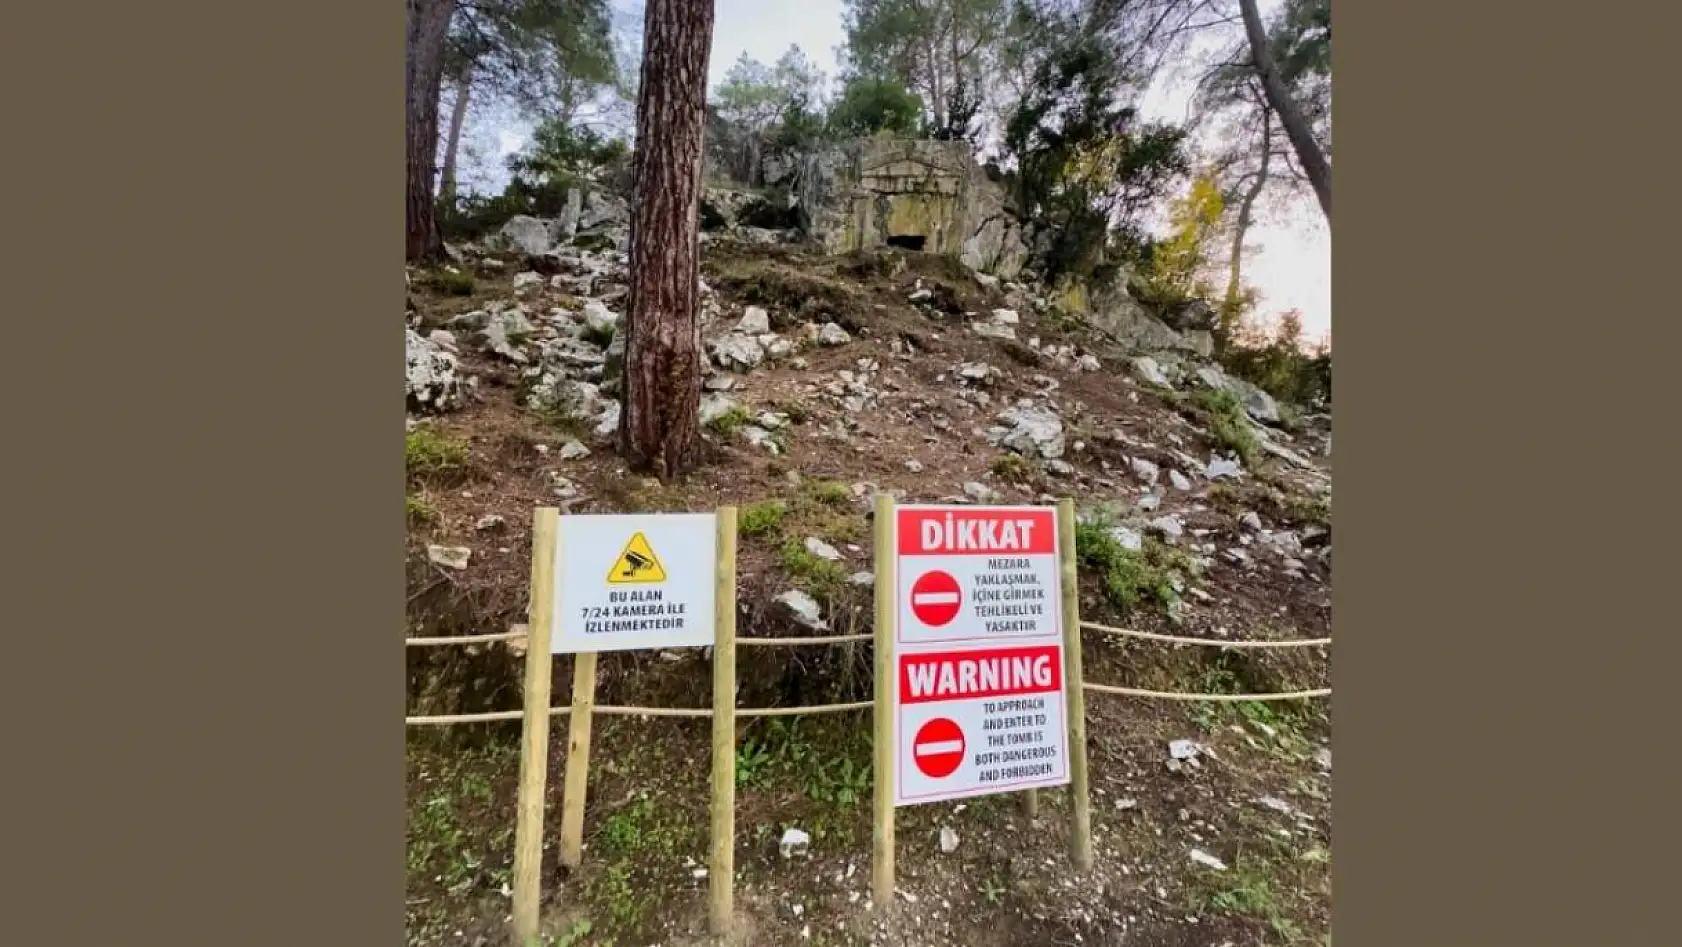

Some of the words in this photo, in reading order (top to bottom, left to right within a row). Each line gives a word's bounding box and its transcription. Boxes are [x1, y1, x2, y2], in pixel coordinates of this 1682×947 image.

[921, 511, 1035, 550] DİKKAT
[988, 558, 1030, 570] MEZARA
[609, 591, 628, 602] BU
[630, 590, 663, 602] ALAN
[972, 588, 1001, 604] İÇİNE
[1003, 586, 1045, 600] GİRMEK
[581, 606, 610, 618] 7/24
[613, 604, 664, 617] KAMERA
[667, 602, 686, 614] İLE
[974, 602, 1027, 617] TEHLİKELİ
[1030, 603, 1044, 615] VE
[585, 616, 684, 632] İZLENMEKTEDİR
[985, 620, 1037, 632] YASAKTIR
[907, 654, 1052, 698] WARNING
[984, 702, 996, 713] TO
[997, 698, 1045, 712] APPROACH
[982, 718, 1003, 730] AND
[1004, 715, 1034, 729] ENTER
[1035, 714, 1047, 725] TO
[987, 734, 1005, 747] THE
[1007, 732, 1033, 745] TOMB
[1034, 731, 1044, 742] IS
[974, 753, 1001, 765] BOTH
[1002, 746, 1057, 762] DANGEROUS
[978, 770, 1000, 782] AND
[1001, 763, 1053, 779] FORBIDDEN
